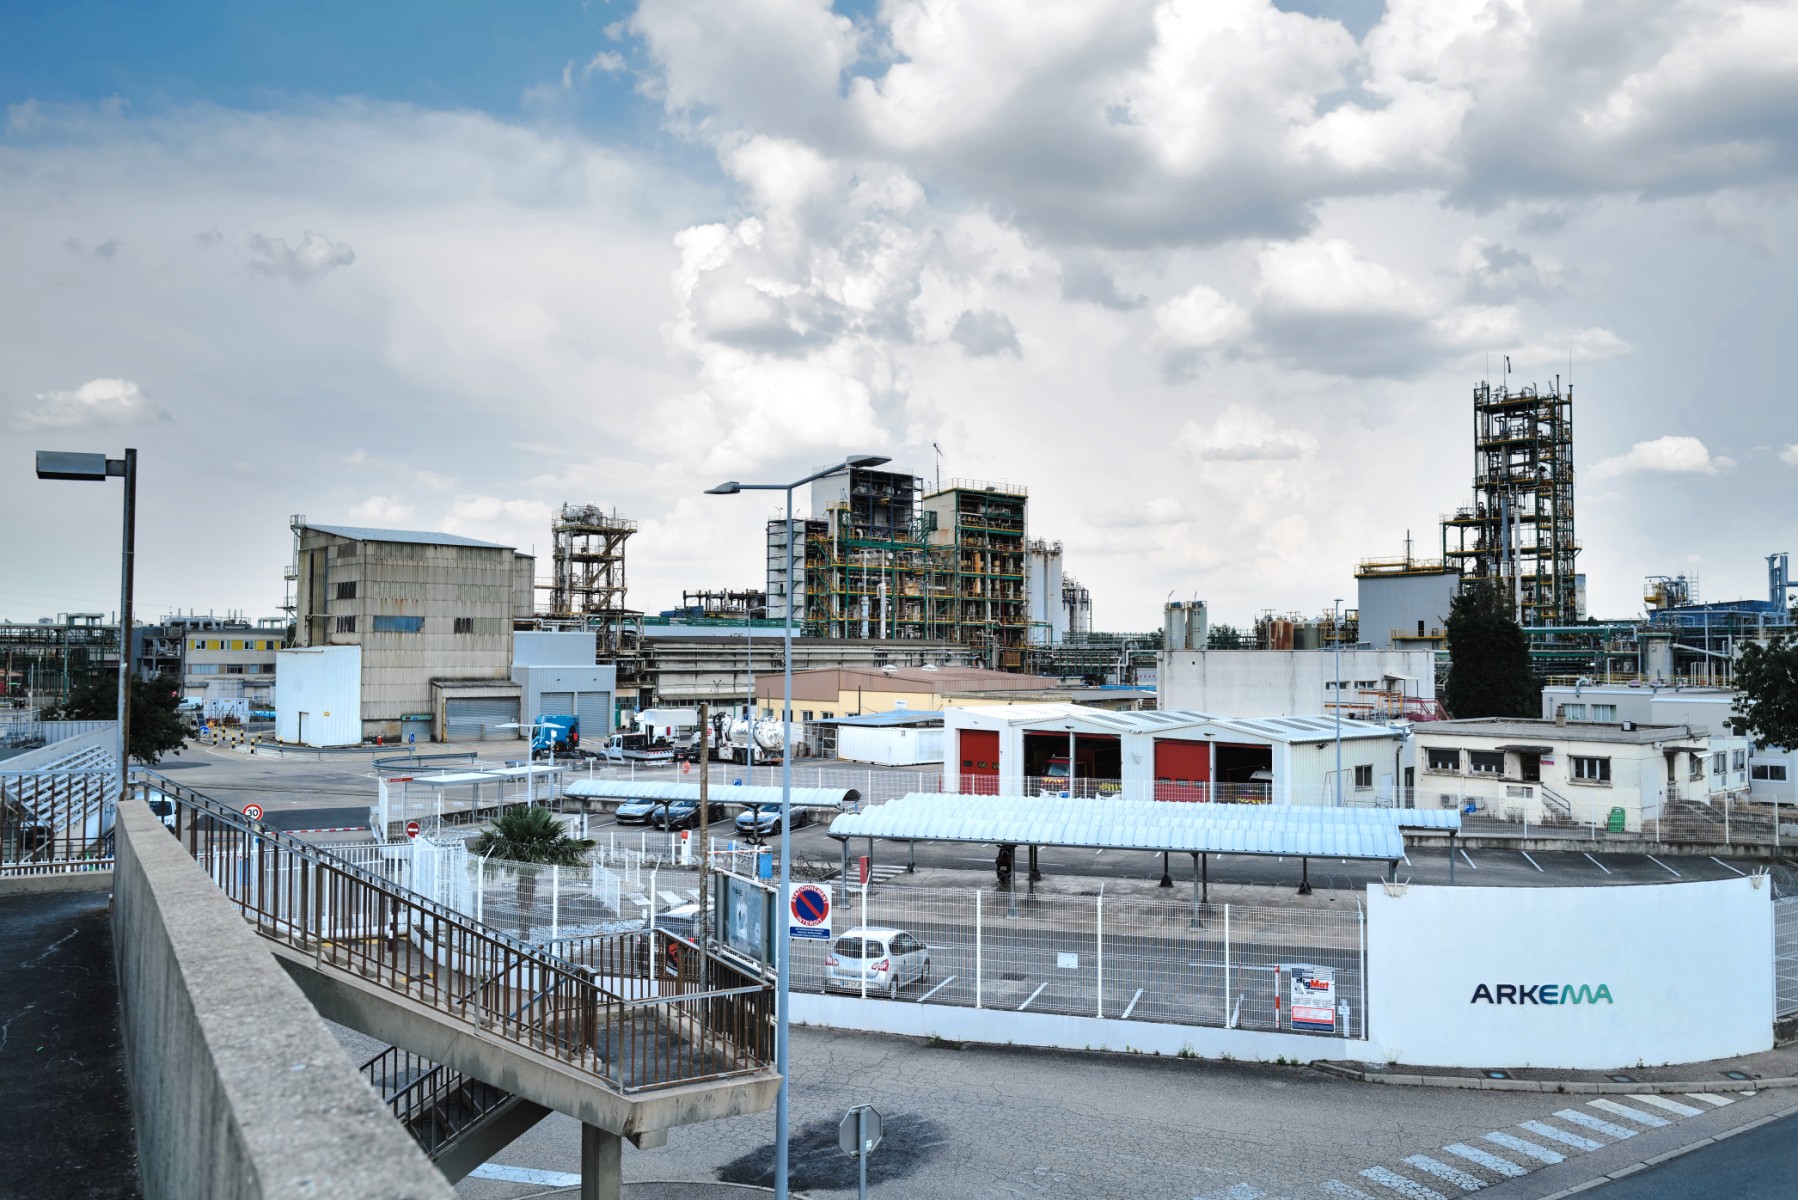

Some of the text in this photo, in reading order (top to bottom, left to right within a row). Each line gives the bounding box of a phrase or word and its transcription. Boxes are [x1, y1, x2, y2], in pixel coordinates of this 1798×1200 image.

[247, 808, 259, 817] 30
[791, 885, 829, 904] STATIONNEMENT
[796, 915, 823, 926] INTERDIT
[1296, 978, 1329, 991] igMat
[1470, 983, 1614, 1005] ARKEMA
